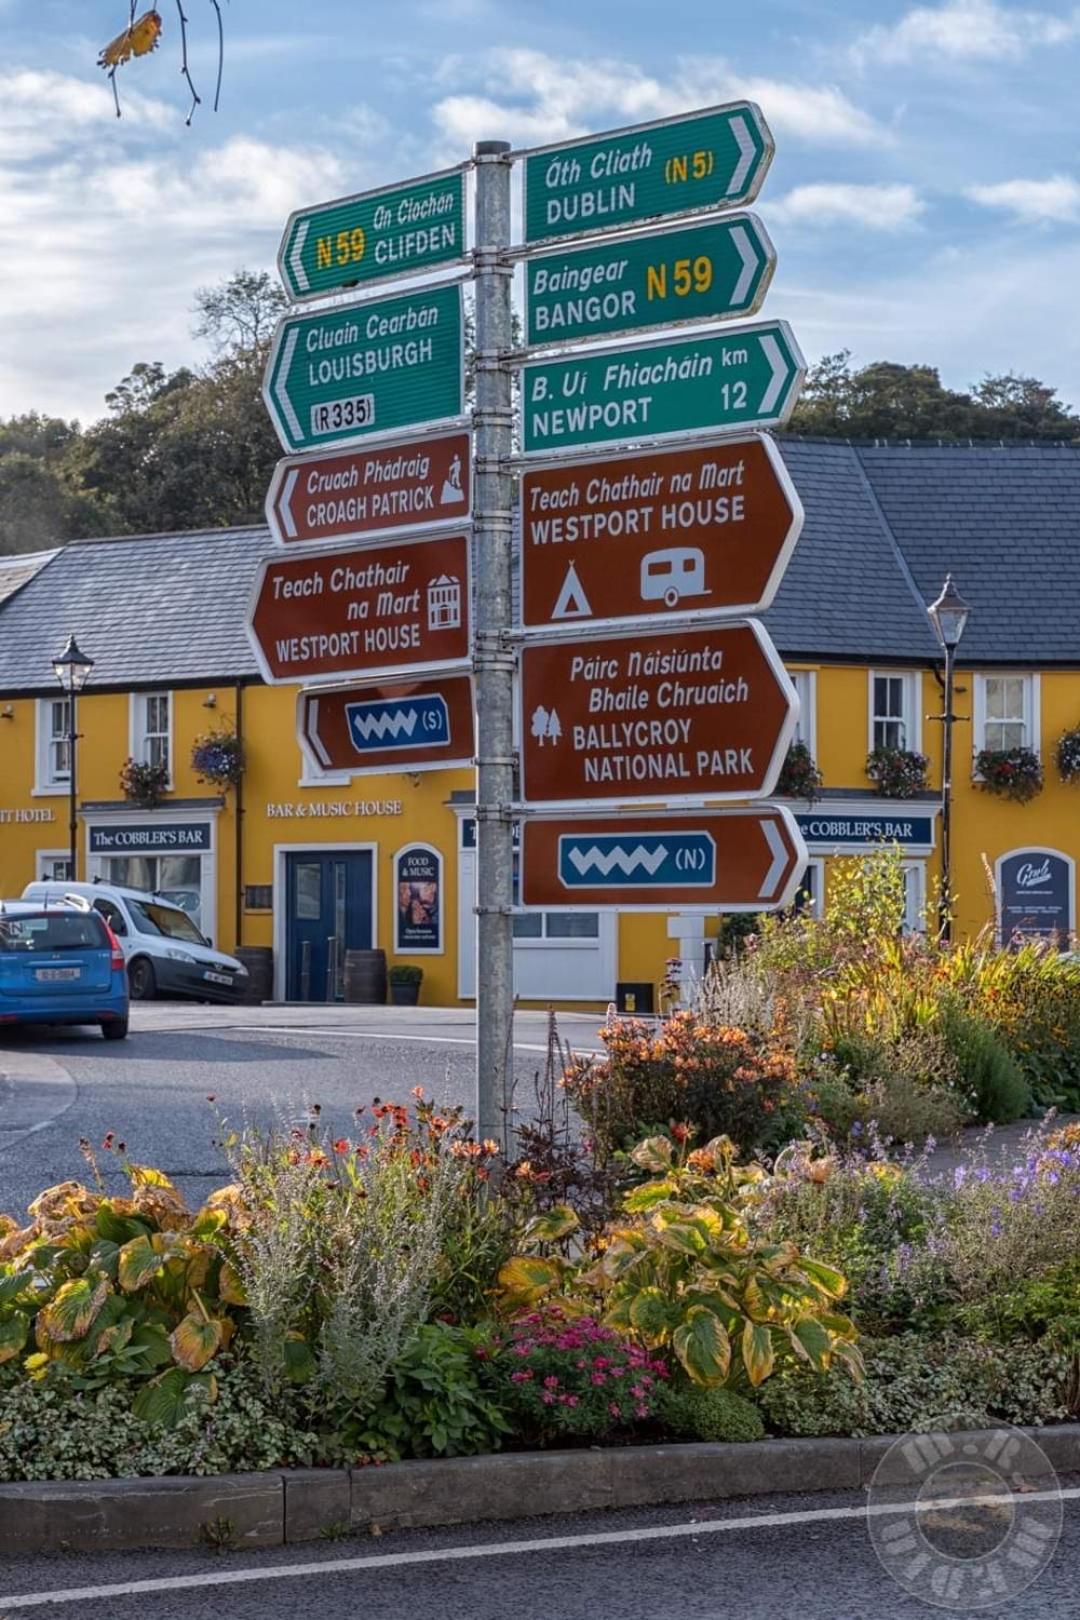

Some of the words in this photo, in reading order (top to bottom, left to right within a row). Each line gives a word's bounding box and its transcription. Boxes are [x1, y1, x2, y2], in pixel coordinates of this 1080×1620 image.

[591, 143, 652, 179] Cliath
[373, 205, 391, 230] An
[398, 192, 454, 224] Clochán
[547, 183, 635, 224] DUBLIN
[374, 224, 455, 264] CLIFDEN
[534, 259, 628, 295] Baingear
[647, 265, 665, 300] N
[674, 256, 712, 296] 59
[306, 322, 358, 352] Cluain
[366, 306, 438, 339] Cearbán
[535, 291, 635, 331] BANGOR
[309, 338, 432, 386] LOUISBURGH
[722, 347, 748, 367] km
[532, 377, 553, 401] B.
[563, 372, 587, 396] Uí
[604, 352, 712, 391] Fhiacháin
[721, 381, 747, 410] 12
[533, 397, 651, 437] NEWPORT
[307, 465, 357, 494] Cruach
[364, 456, 430, 486] Phádraig
[530, 482, 579, 511] Teach
[586, 471, 663, 505] Chathair
[671, 474, 691, 493] na
[700, 460, 744, 488] Mart
[307, 496, 366, 526] CROAGH
[372, 485, 434, 517] PATRICK
[531, 506, 652, 545] WESTPORT
[662, 496, 744, 530] HOUSE
[273, 575, 323, 599] Teach
[331, 562, 409, 592] Chathair
[348, 601, 368, 620] na
[377, 590, 420, 617] Mart
[276, 631, 359, 662] WESTPORT
[365, 624, 420, 650] HOUSE
[571, 655, 617, 682] Páirc
[629, 647, 722, 677] Náisiúnta
[589, 685, 648, 713] Bhaile
[657, 676, 748, 708] Chruaich
[423, 710, 442, 730] (S)
[574, 719, 691, 750] BALLYCROY
[584, 751, 690, 782] NATIONAL
[697, 748, 754, 776] PARK
[16, 808, 55, 822] HOTEL
[267, 803, 293, 817] BAR
[296, 803, 305, 817] &
[309, 802, 352, 816] MUSIC
[355, 800, 402, 815] HOUSE
[94, 832, 114, 846] The
[115, 831, 176, 845] COBBLER'S
[178, 831, 203, 843] BAR
[810, 822, 882, 836] COBBLER'S
[885, 822, 912, 837] BAR
[407, 858, 429, 866] FOOD
[410, 867, 434, 877] MUSIC
[675, 848, 705, 870] (N)
